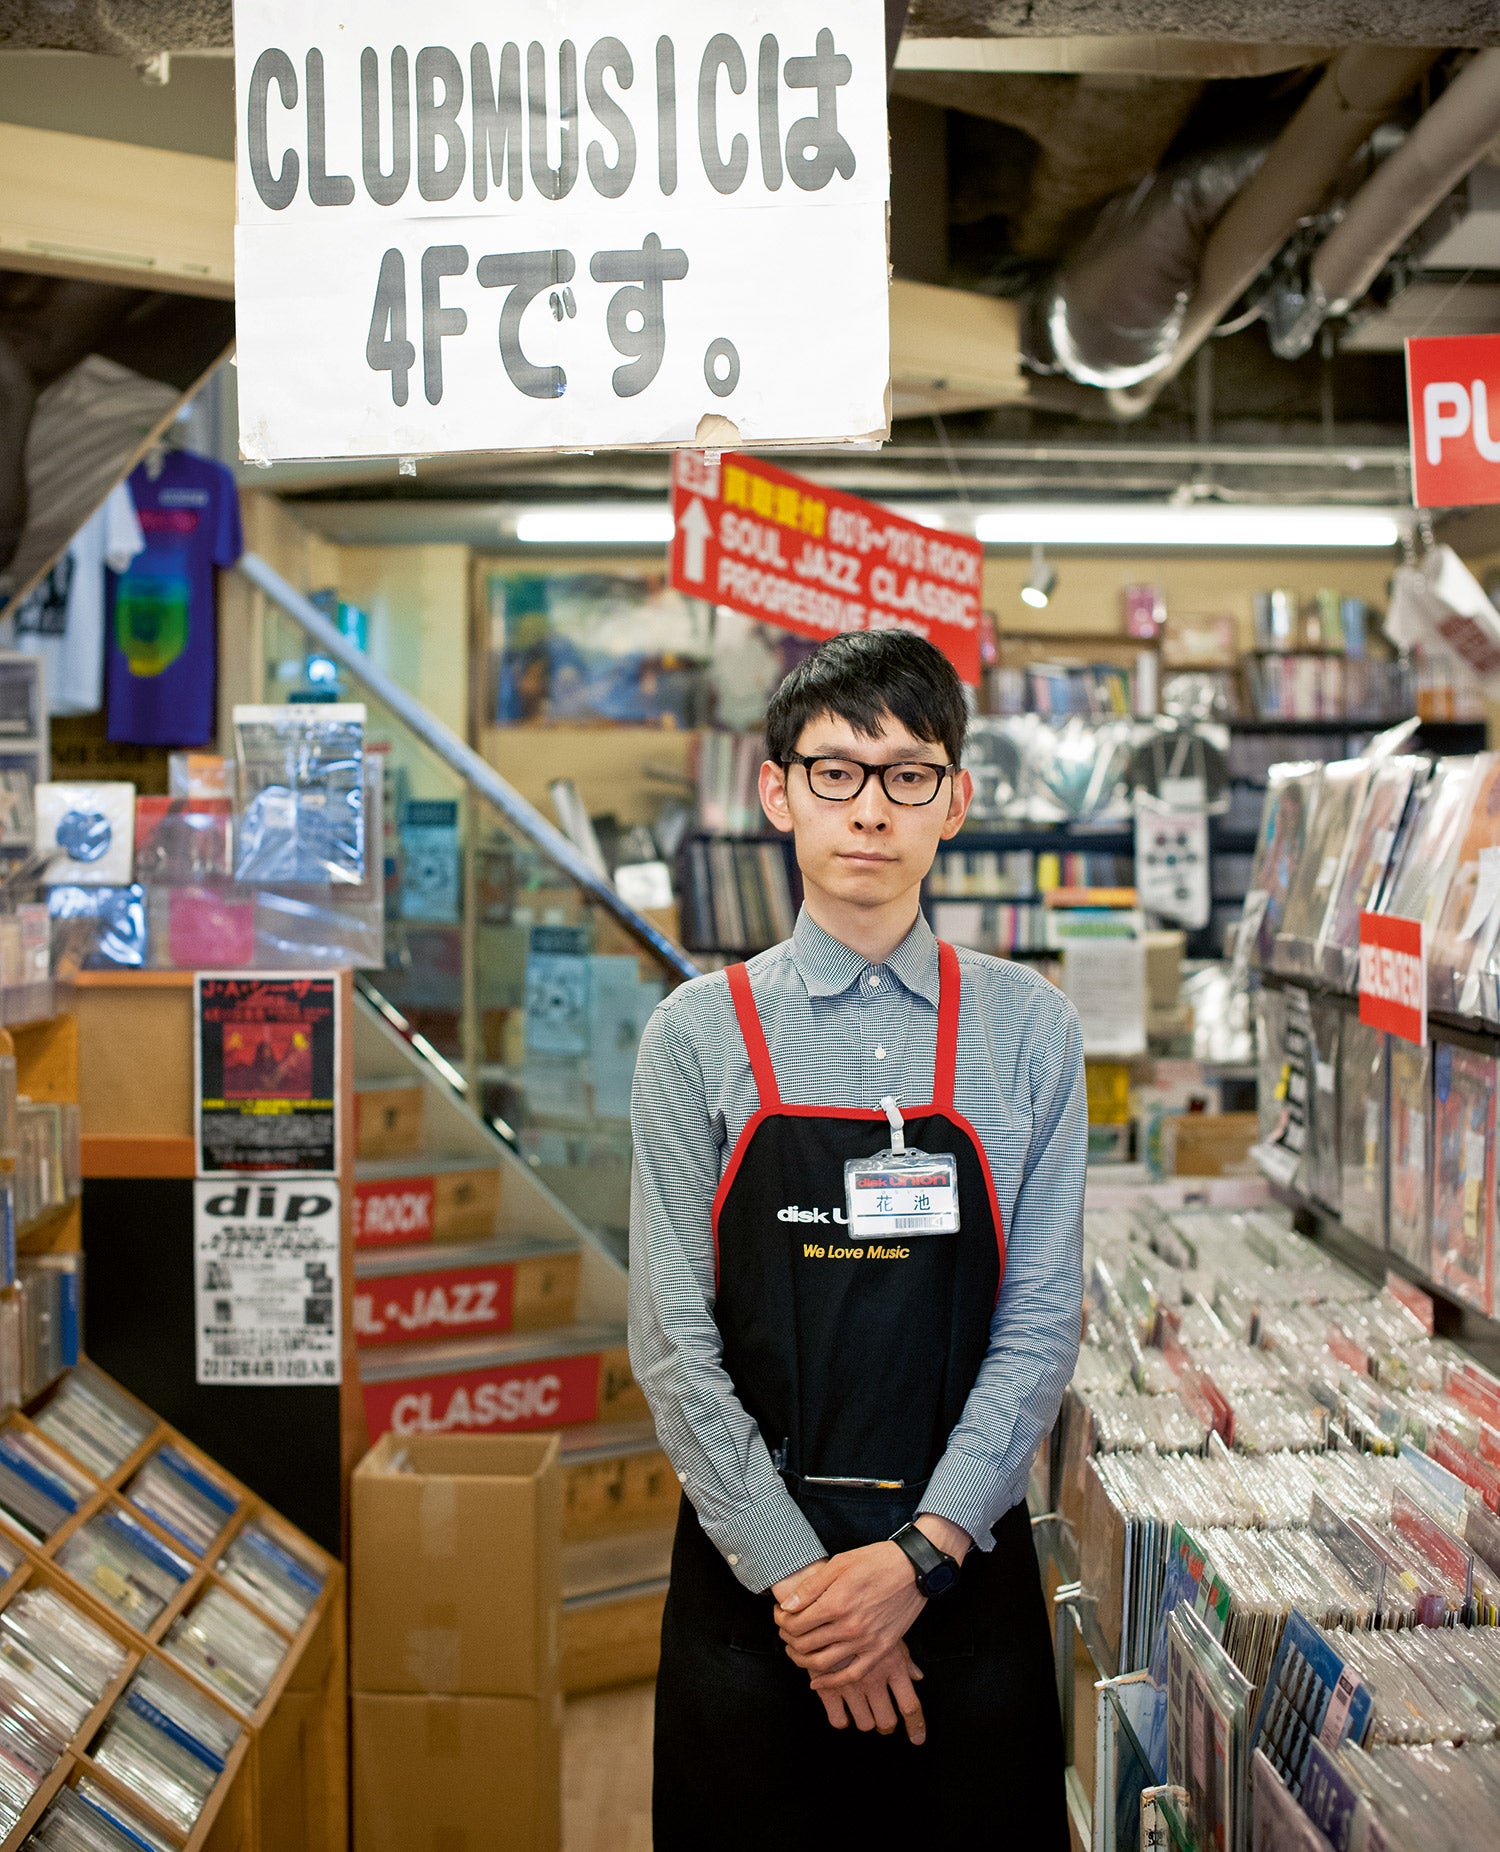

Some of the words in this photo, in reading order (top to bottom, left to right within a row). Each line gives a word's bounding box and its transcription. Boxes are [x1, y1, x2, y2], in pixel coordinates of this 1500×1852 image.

[366, 233, 740, 406] 4Fです。
[719, 511, 787, 569] SOUL
[793, 542, 861, 595] JAZZ
[870, 566, 977, 629] CLASSIC
[717, 557, 866, 631] PROGRESSIVE
[857, 1177, 888, 1188] disk
[205, 1187, 332, 1222] dip
[365, 1194, 432, 1235] ROCK
[776, 1206, 830, 1224] disk
[803, 1244, 825, 1258] We
[828, 1245, 864, 1259] Love
[866, 1245, 910, 1259] Music
[391, 1374, 561, 1435] CLASSIC
